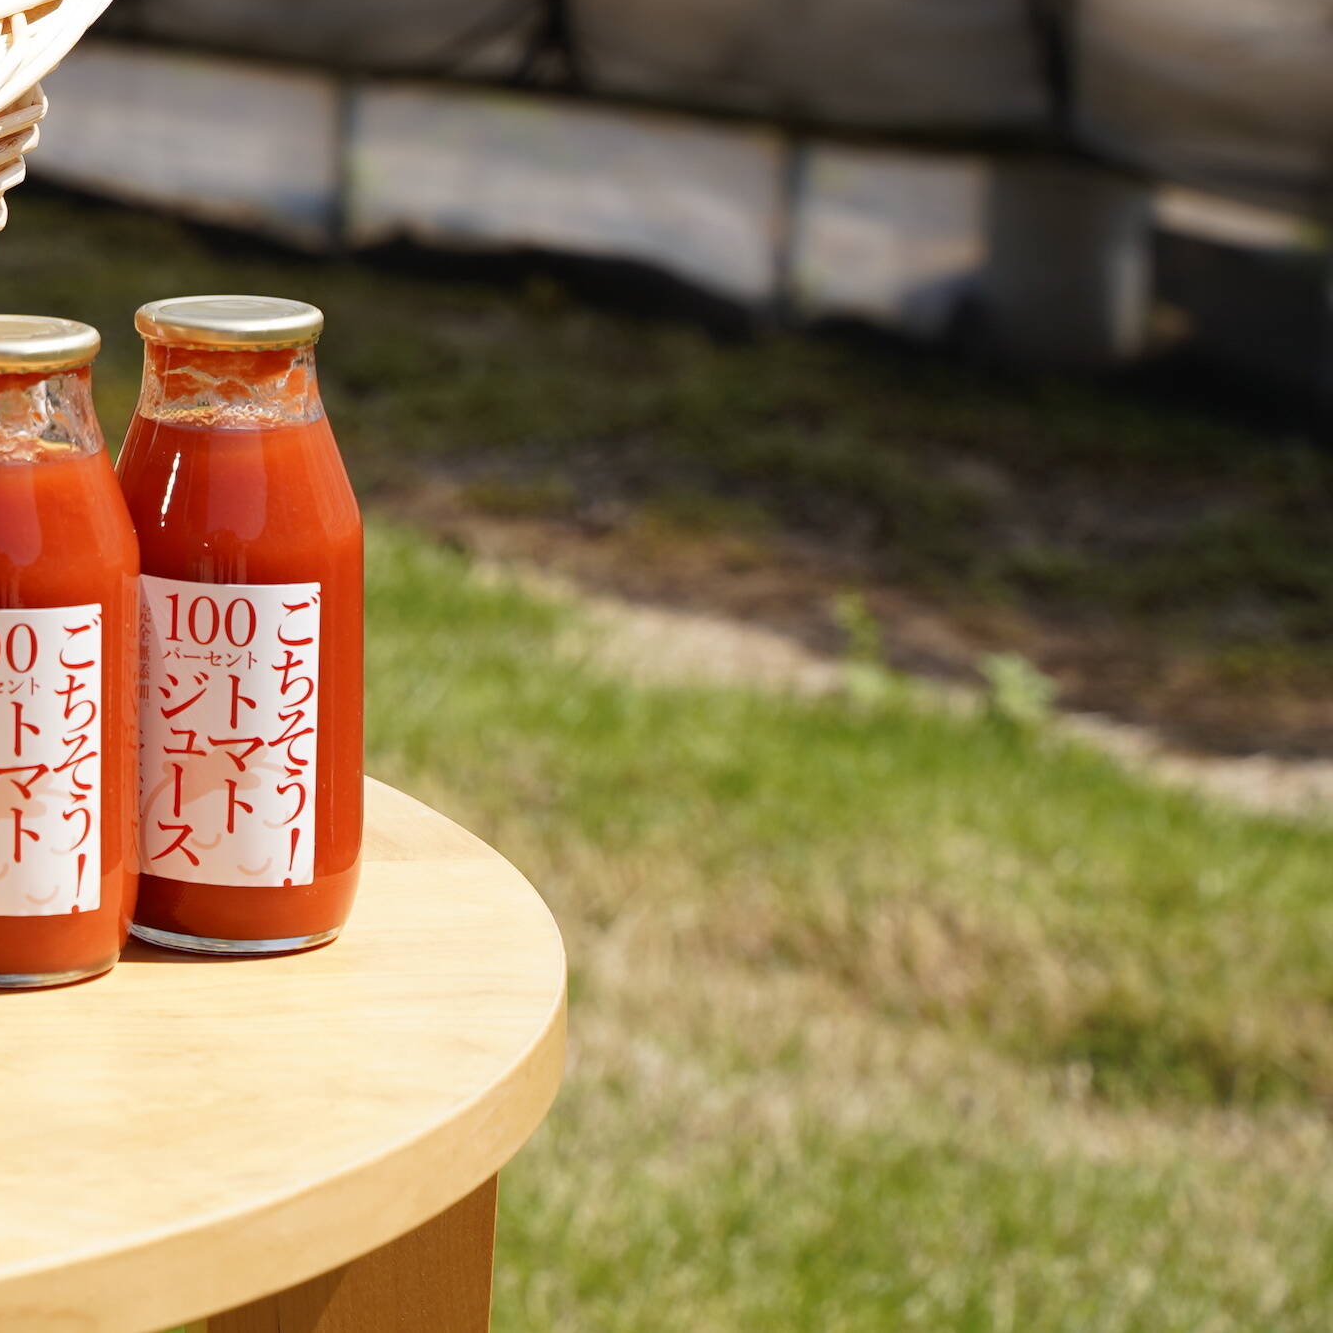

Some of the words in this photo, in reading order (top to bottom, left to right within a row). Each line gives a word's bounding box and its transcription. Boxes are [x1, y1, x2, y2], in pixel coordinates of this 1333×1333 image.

[163, 650, 258, 670] パーセント
[165, 593, 257, 647] 100
[52, 613, 101, 914] ごちそう！
[151, 672, 209, 867] ジュース
[207, 674, 265, 834] トマト
[268, 591, 321, 888] ごちそう！
